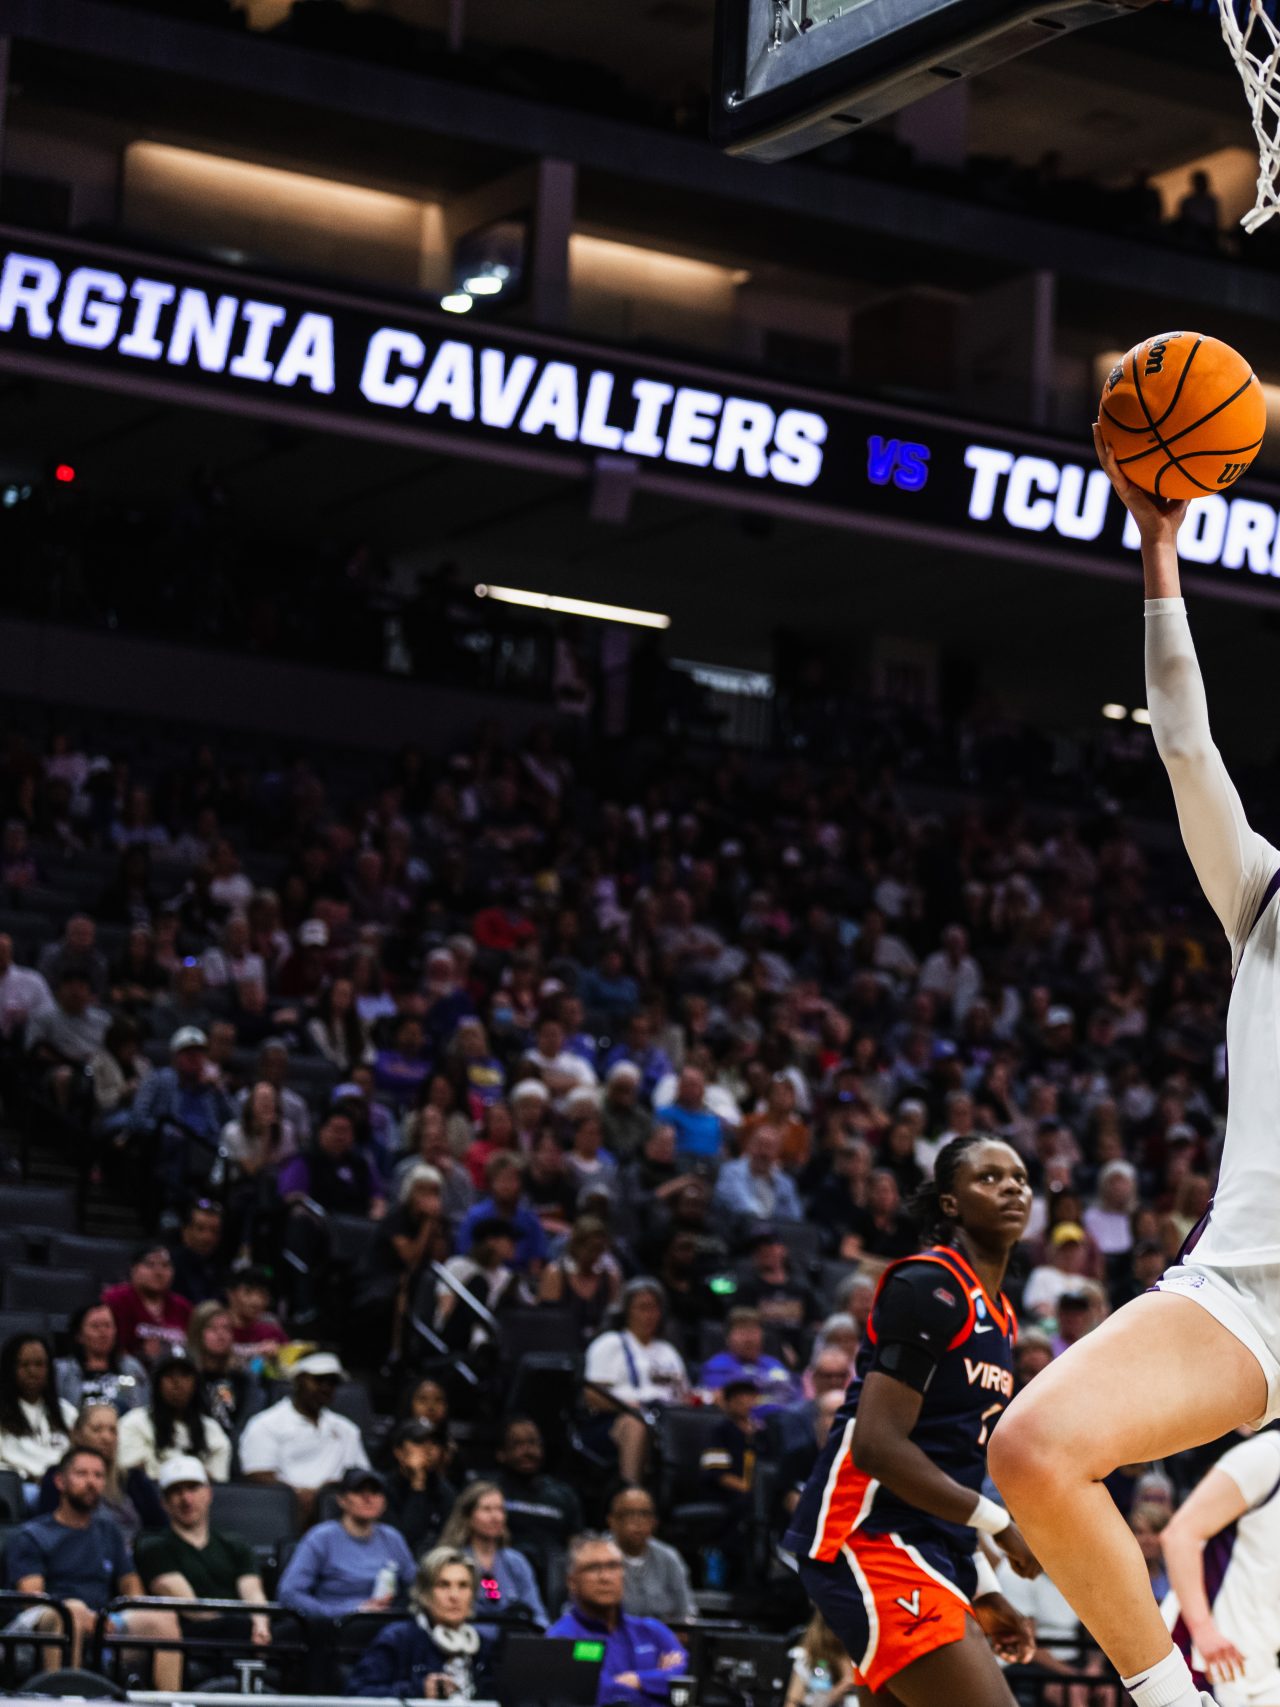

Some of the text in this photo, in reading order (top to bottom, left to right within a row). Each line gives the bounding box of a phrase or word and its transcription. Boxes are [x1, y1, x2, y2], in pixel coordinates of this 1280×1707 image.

[0, 252, 336, 393] RGINIA
[360, 327, 828, 487] CAVALIERS
[867, 435, 931, 493] VS
[964, 445, 1112, 541] TCU
